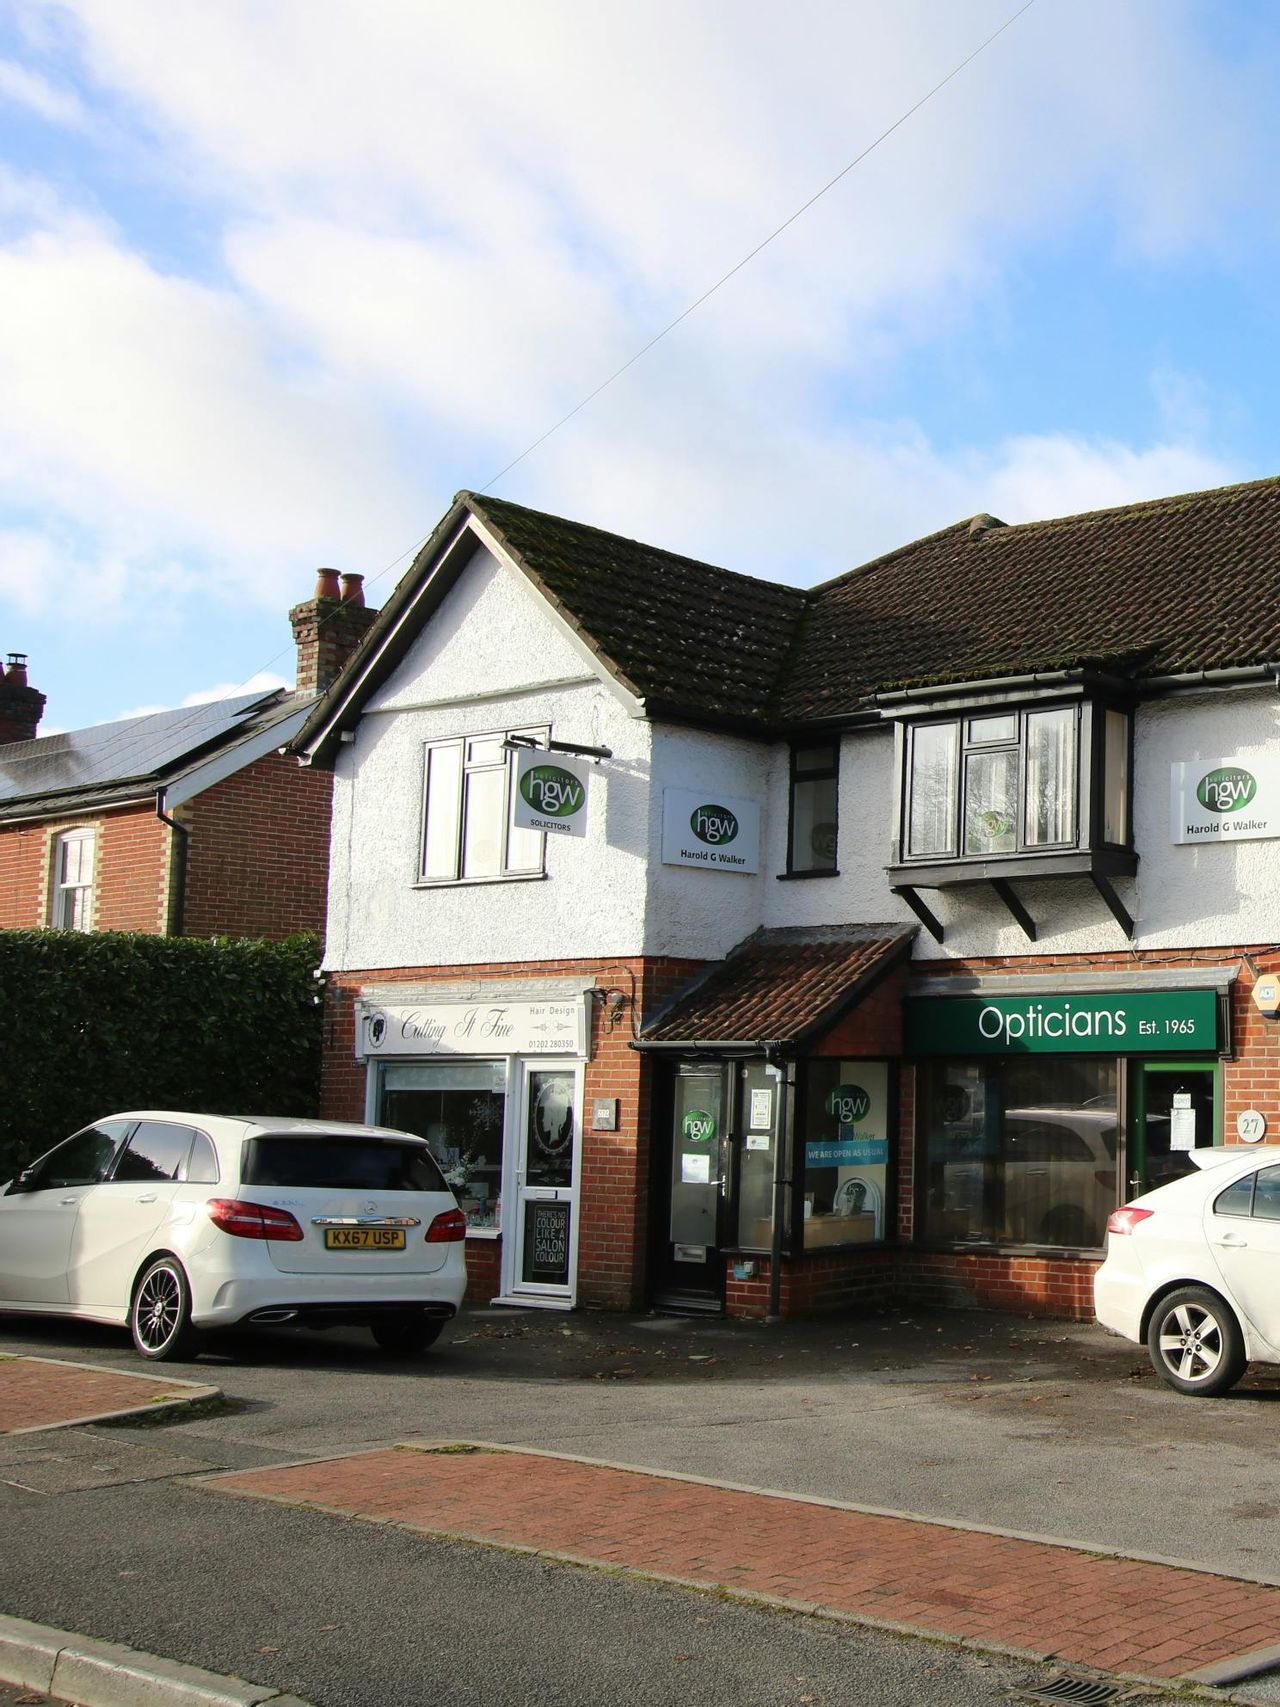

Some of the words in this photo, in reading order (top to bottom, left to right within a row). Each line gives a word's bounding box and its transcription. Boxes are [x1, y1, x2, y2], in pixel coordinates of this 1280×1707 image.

[529, 770, 580, 812] hgw
[1205, 776, 1252, 810] hgw
[530, 819, 571, 831] SOLICITORS
[697, 809, 735, 842] hgw
[1186, 823, 1219, 834] Harold
[1222, 822, 1230, 831] G
[1233, 820, 1268, 831] Walker
[680, 849, 708, 860] Harold
[710, 853, 717, 861] G
[719, 854, 746, 865] Walker
[549, 1007, 575, 1016] Design
[400, 1009, 446, 1048] Cutting
[454, 1007, 480, 1038] It
[480, 1007, 514, 1038] Fine
[978, 1003, 1127, 1046] Opticians
[1138, 1020, 1160, 1035] Est.
[1164, 1019, 1195, 1034] 1965
[529, 1040, 548, 1048] 01202
[832, 1091, 867, 1123] hgw
[684, 1115, 713, 1140] hgw
[1242, 1118, 1260, 1134] 27
[808, 1151, 819, 1159] WE
[820, 1150, 832, 1158] ARE
[833, 1149, 852, 1158] OPEN
[853, 1149, 861, 1157] AS
[863, 1148, 884, 1157] USUAL
[536, 1217, 566, 1229] COLOUR
[332, 1231, 369, 1245] KX67
[373, 1231, 400, 1245] USP
[536, 1228, 556, 1239] LIKE
[558, 1229, 566, 1240] A
[535, 1239, 565, 1252] SALON
[535, 1251, 565, 1263] COLOUR
